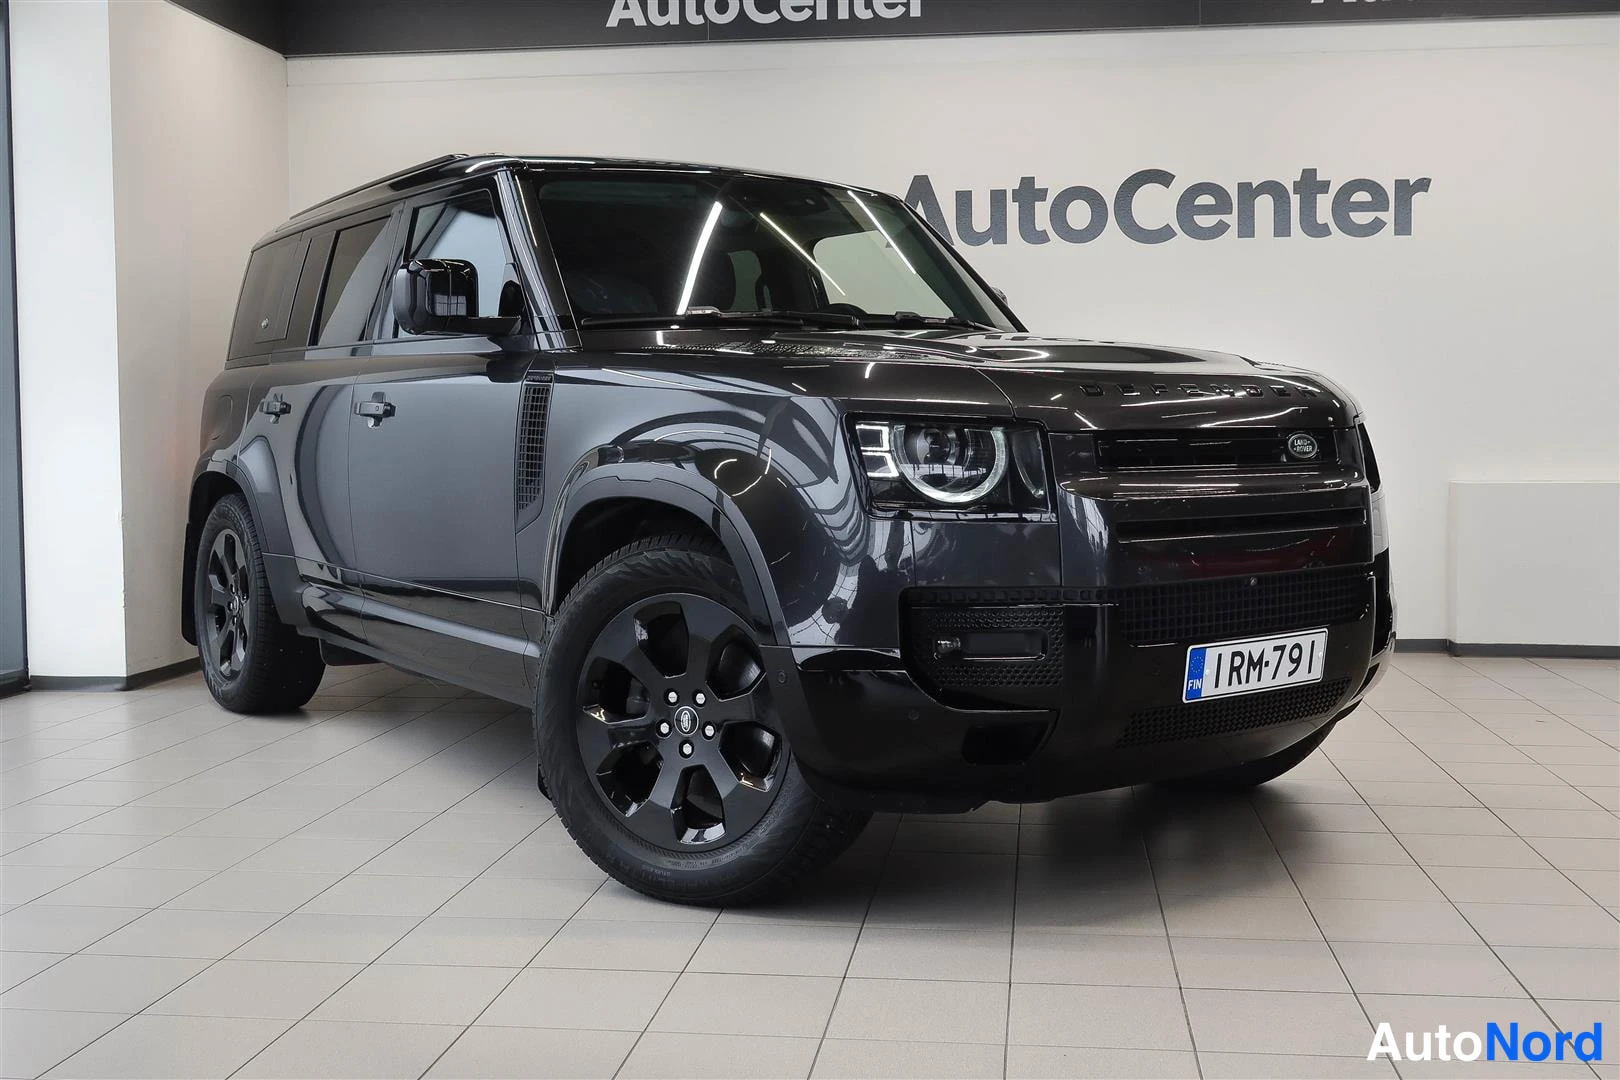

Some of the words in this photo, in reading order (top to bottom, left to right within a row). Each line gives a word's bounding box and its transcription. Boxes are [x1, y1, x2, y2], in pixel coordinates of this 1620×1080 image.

[886, 167, 1432, 248] AutoCenter
[1187, 678, 1203, 691] FIN
[1214, 640, 1315, 688] IRM-791
